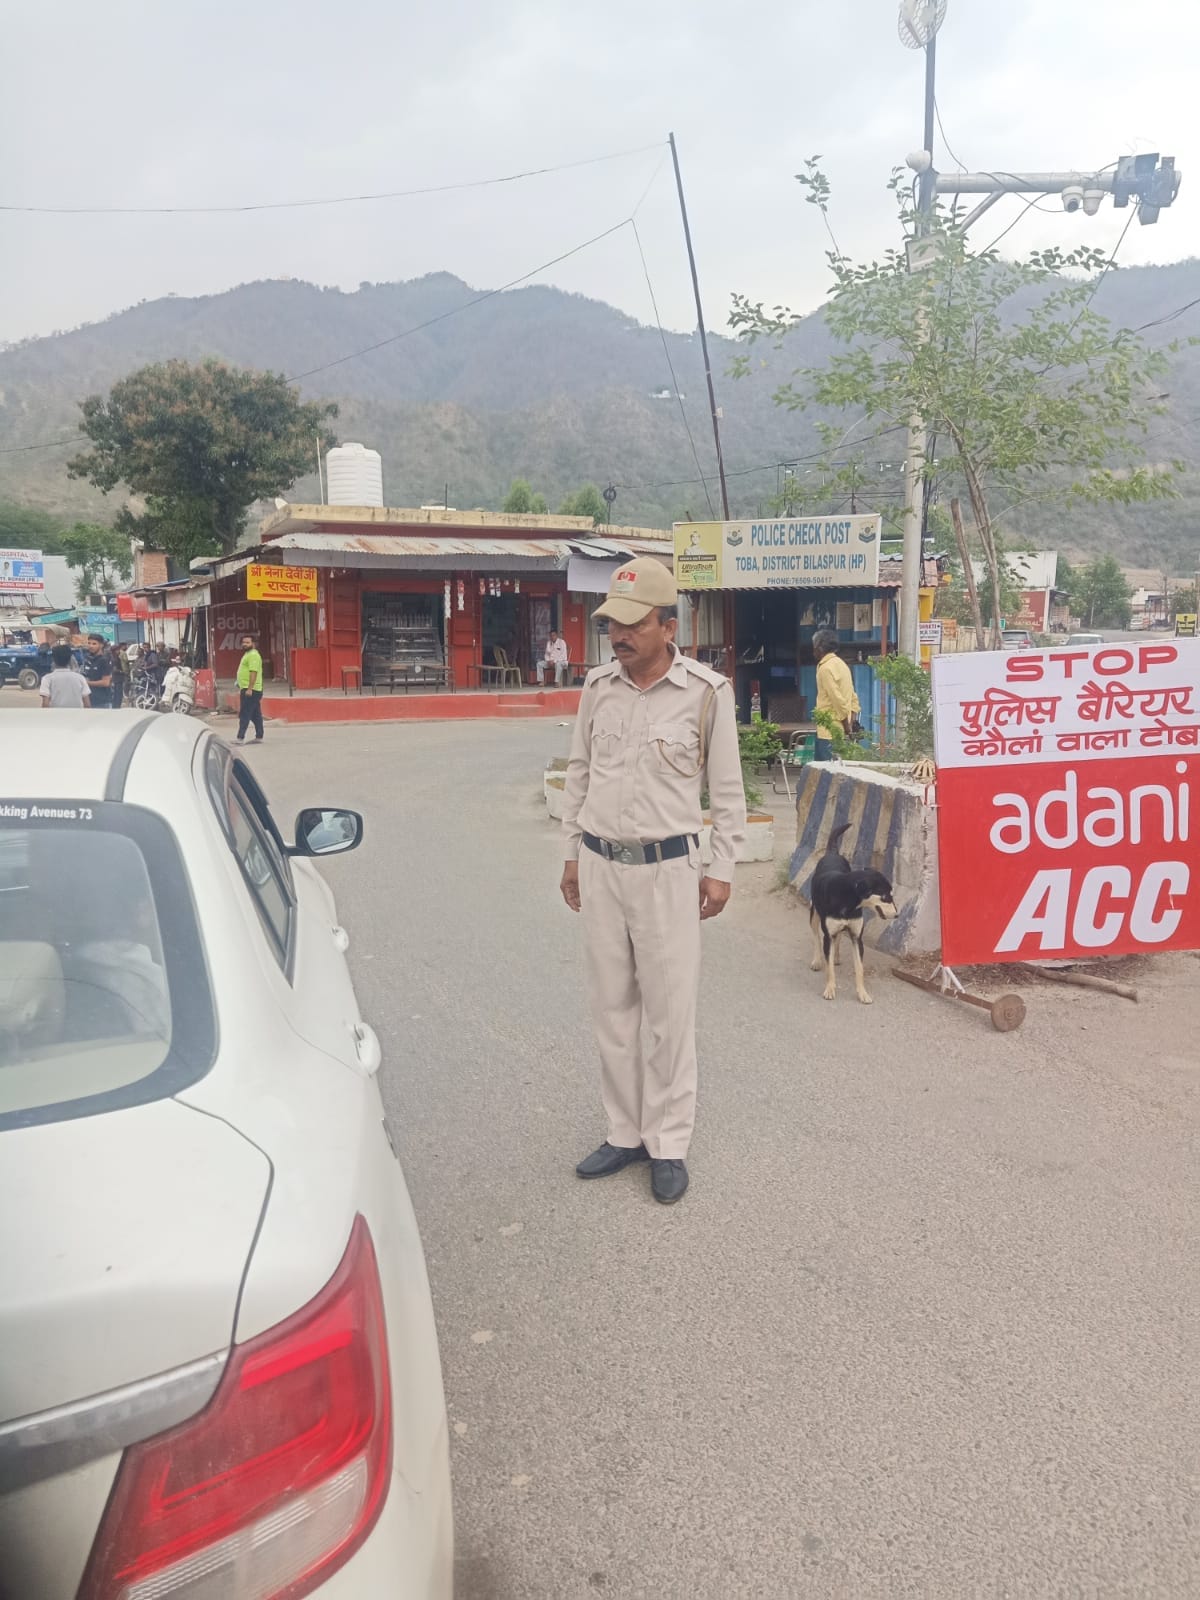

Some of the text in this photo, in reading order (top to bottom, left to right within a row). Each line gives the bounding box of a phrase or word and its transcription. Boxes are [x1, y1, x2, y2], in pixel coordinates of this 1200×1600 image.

[751, 521, 851, 545] POLICE CHECK POST
[251, 566, 262, 577] श्री
[264, 565, 284, 578] नैना
[735, 553, 867, 573] TOBA, DISTRICT BILASPUR (HP)
[267, 581, 301, 593] रास्ता
[1006, 645, 1178, 682] STOP
[959, 680, 1195, 737] पुलिस बैरियर
[961, 727, 1044, 756] कौलां
[1056, 729, 1132, 751] वाला
[30, 805, 77, 819] Avenues
[79, 808, 93, 820] 73
[989, 760, 1190, 854] adani
[992, 861, 1191, 953] ACC
